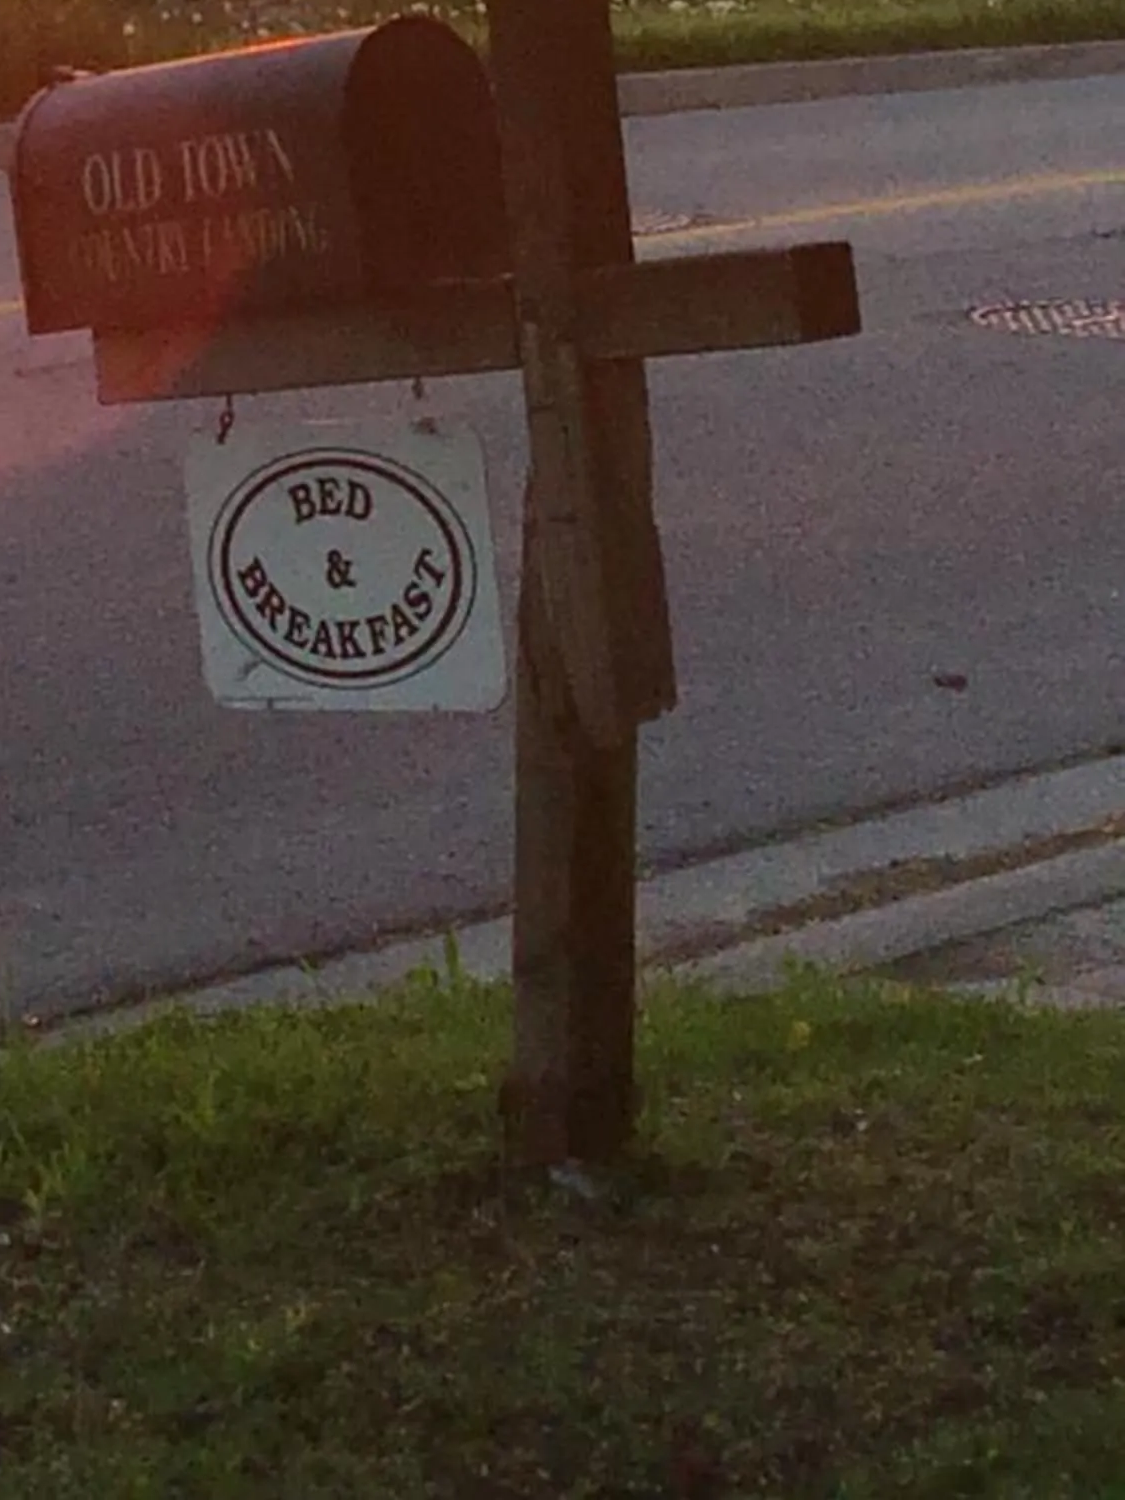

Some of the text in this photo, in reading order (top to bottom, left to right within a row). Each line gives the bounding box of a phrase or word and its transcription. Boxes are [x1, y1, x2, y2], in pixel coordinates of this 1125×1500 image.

[82, 128, 294, 215] OLD TOWN
[287, 476, 373, 525] BED
[237, 547, 446, 660] BREAKFAST
[325, 549, 357, 590] &
